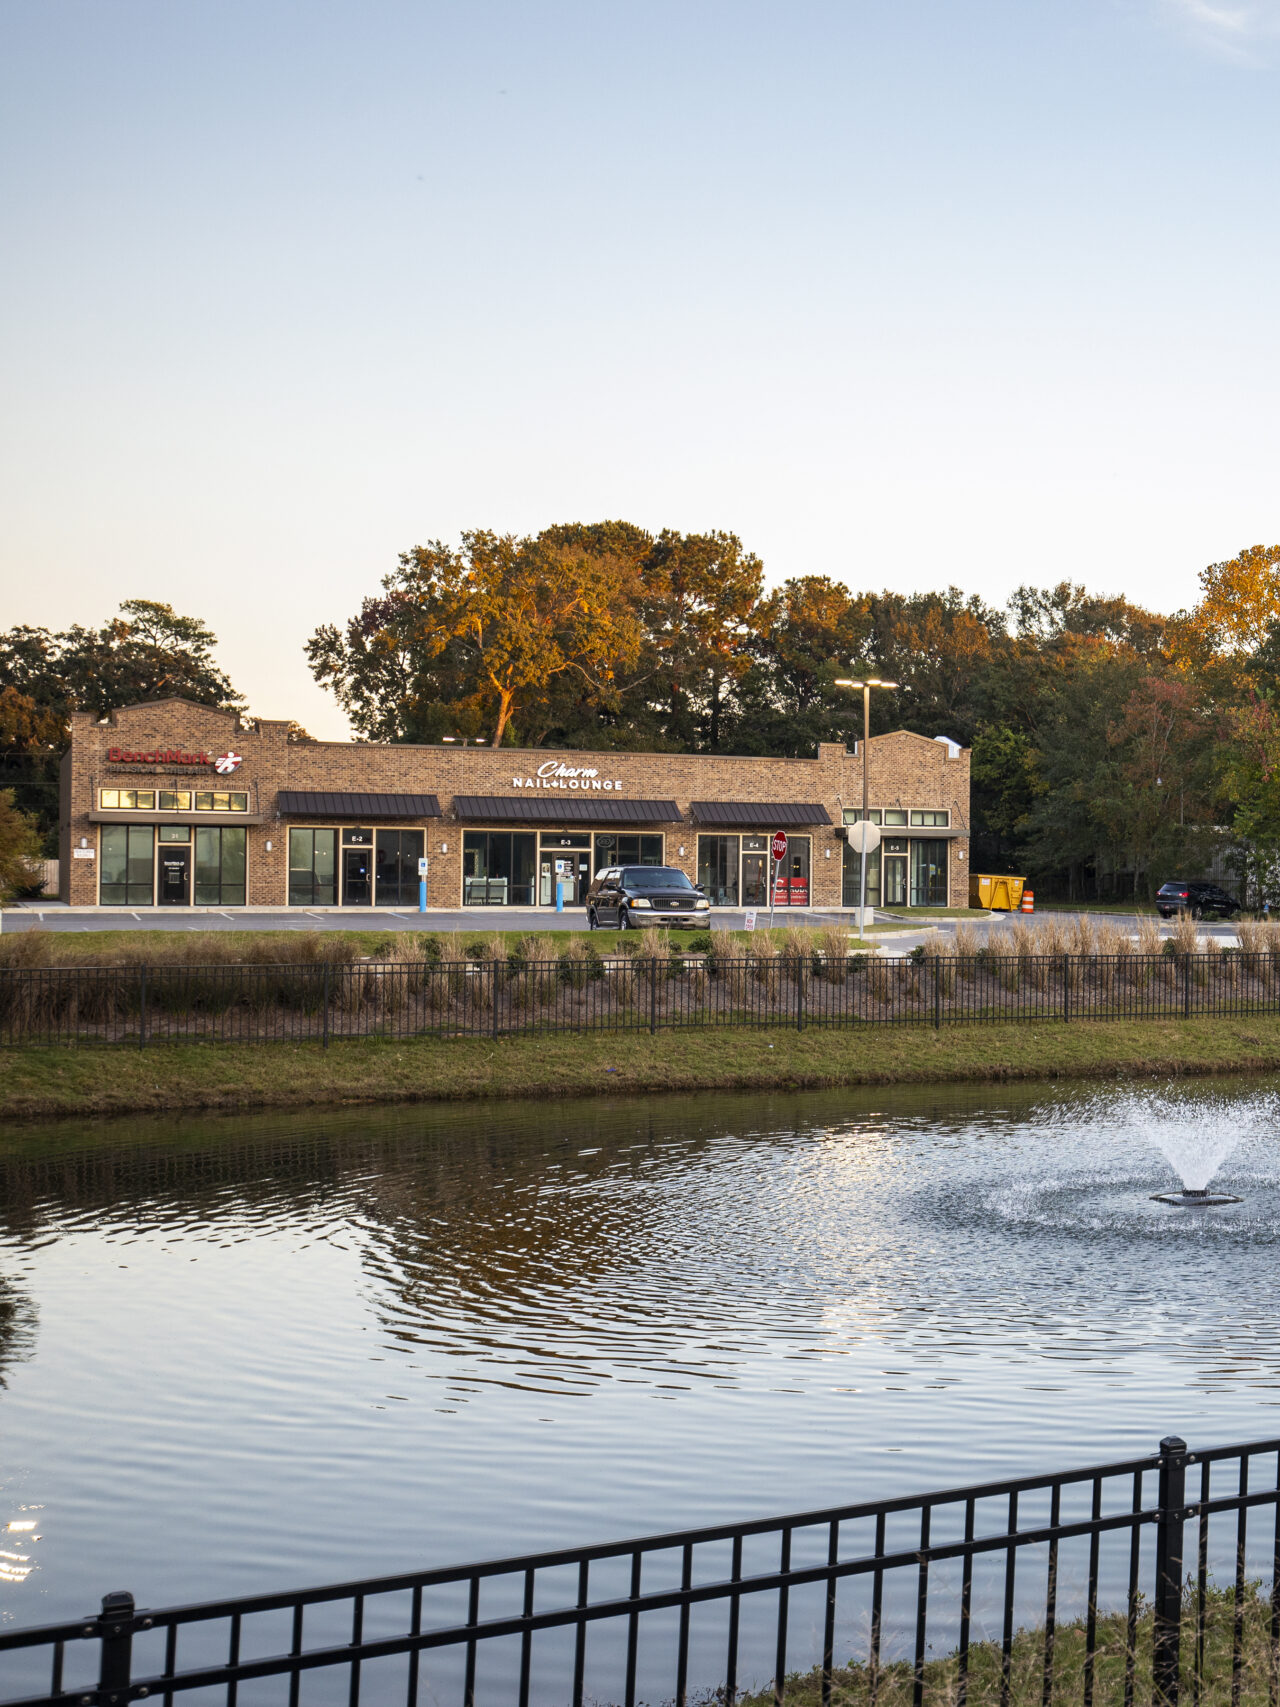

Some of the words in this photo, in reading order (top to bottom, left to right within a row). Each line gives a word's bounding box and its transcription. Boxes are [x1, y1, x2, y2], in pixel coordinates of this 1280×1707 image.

[108, 747, 211, 764] BenchMark
[537, 760, 599, 778] Charm
[512, 777, 550, 788] NAIL
[560, 779, 622, 790] LOUNGE
[773, 839, 787, 852] STOP
